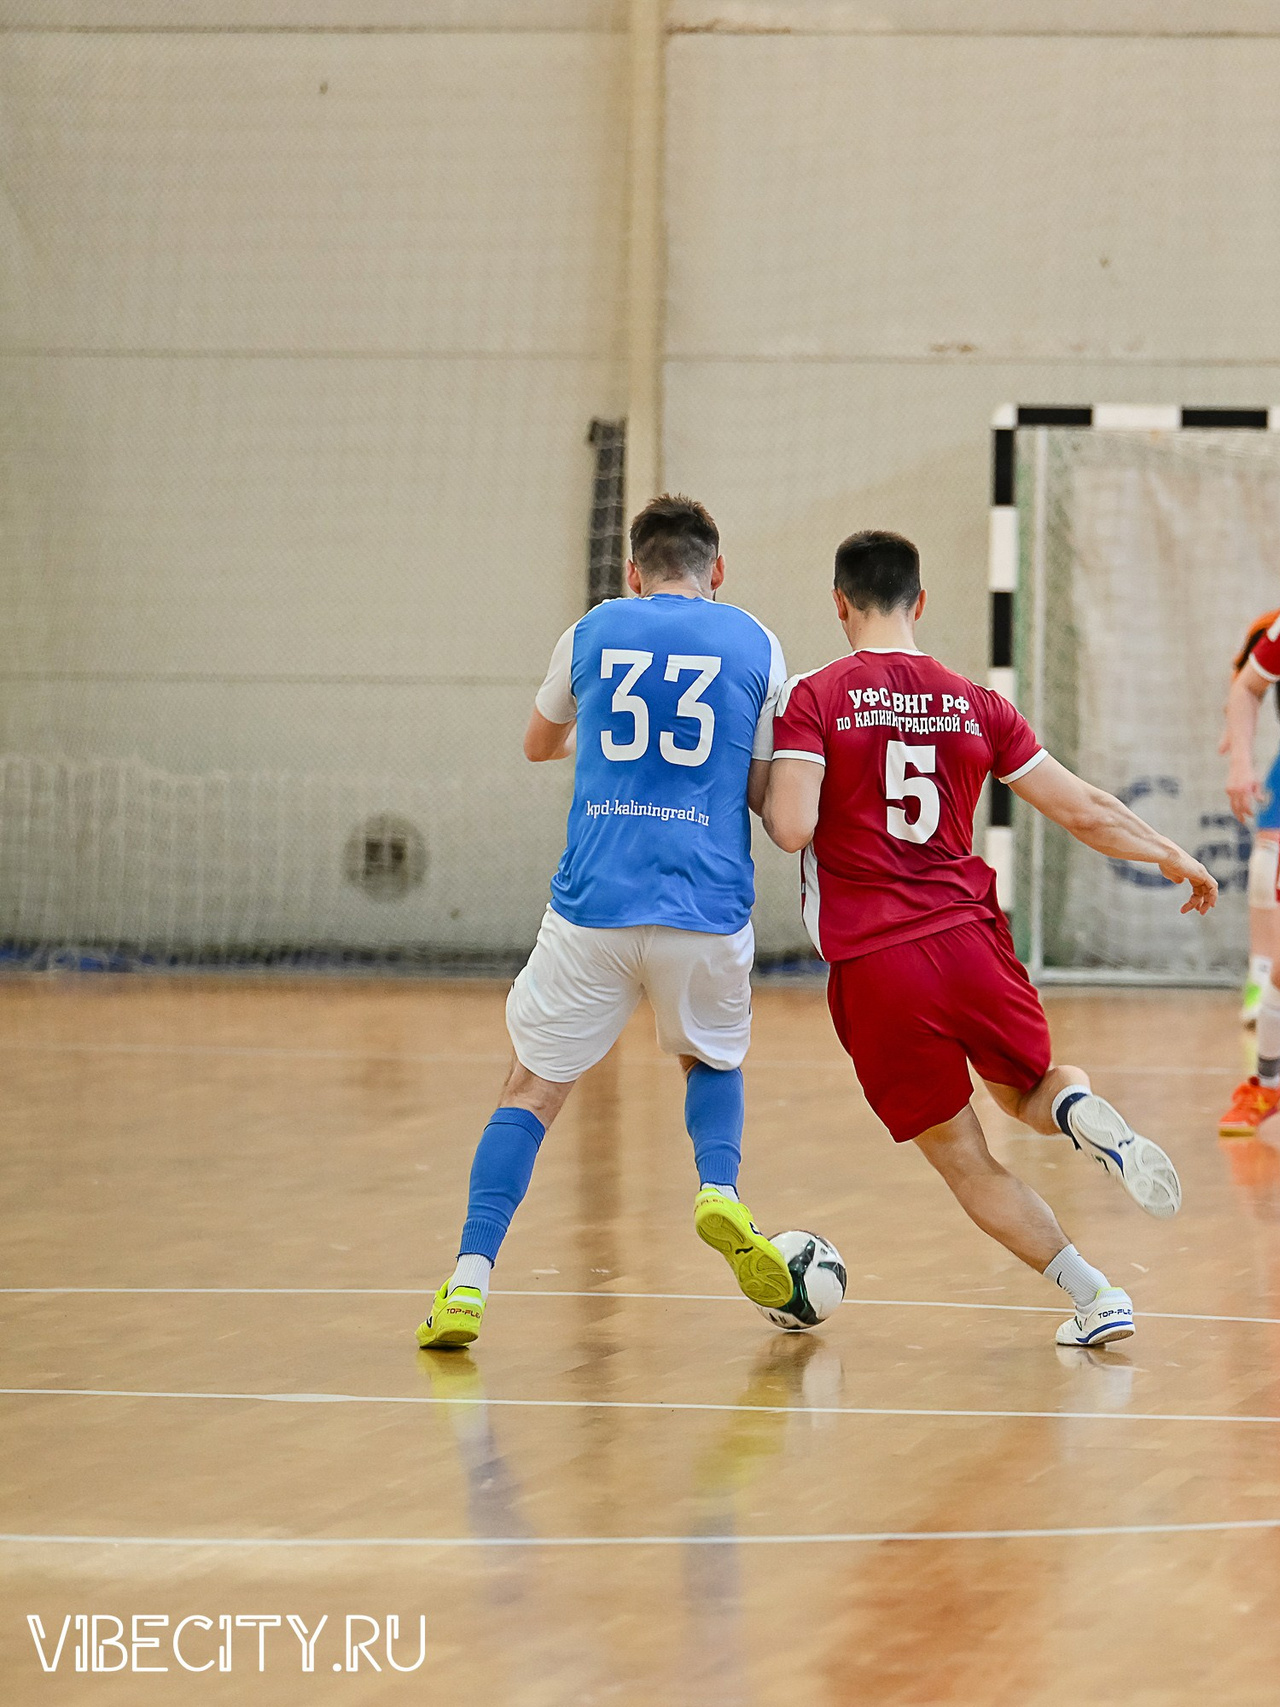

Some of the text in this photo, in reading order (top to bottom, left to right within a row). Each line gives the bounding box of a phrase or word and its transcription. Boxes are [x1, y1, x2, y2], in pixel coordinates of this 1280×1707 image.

[600, 648, 722, 767] 33
[847, 687, 970, 714] УФСВНГ РФ
[854, 709, 961, 735] КАЛИНИГРАДСКОЙ
[885, 739, 941, 845] 5
[586, 799, 710, 827] kpd-kaliningrad.ru
